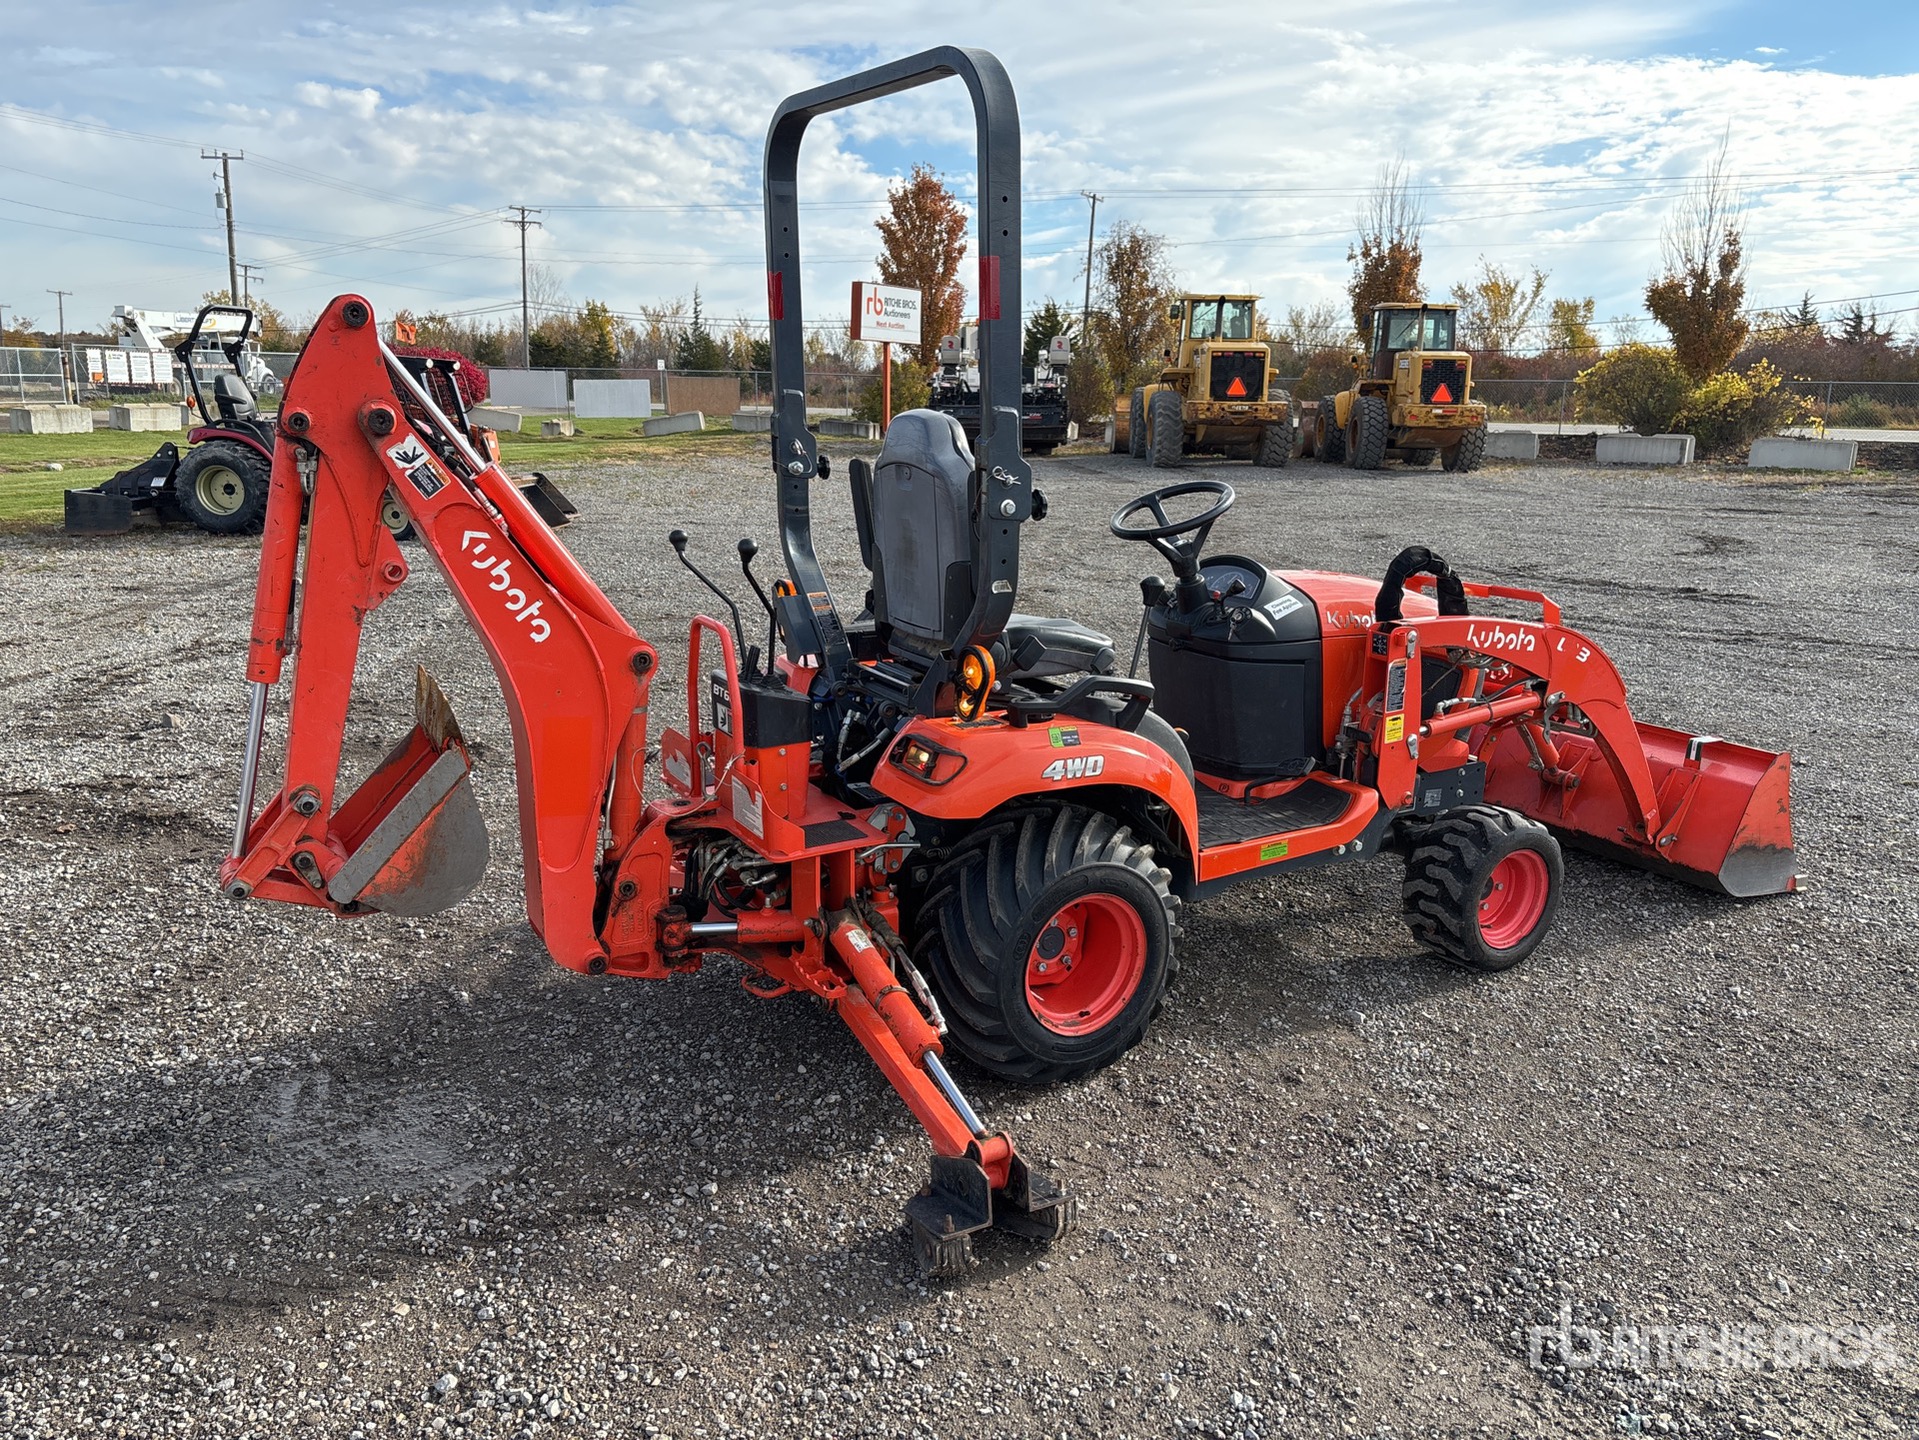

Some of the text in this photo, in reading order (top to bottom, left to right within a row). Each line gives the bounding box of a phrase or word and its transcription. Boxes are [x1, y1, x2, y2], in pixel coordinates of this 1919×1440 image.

[866, 287, 884, 315] rb
[884, 297, 917, 310] RITCHIE BROS.
[884, 308, 911, 319] Auctioneers
[889, 322, 905, 330] Auction
[461, 530, 551, 643] Kubota
[1326, 610, 1376, 629] Kubot
[1466, 623, 1536, 652] Kubota
[713, 683, 730, 701] BT6
[1041, 754, 1105, 782] 4WD
